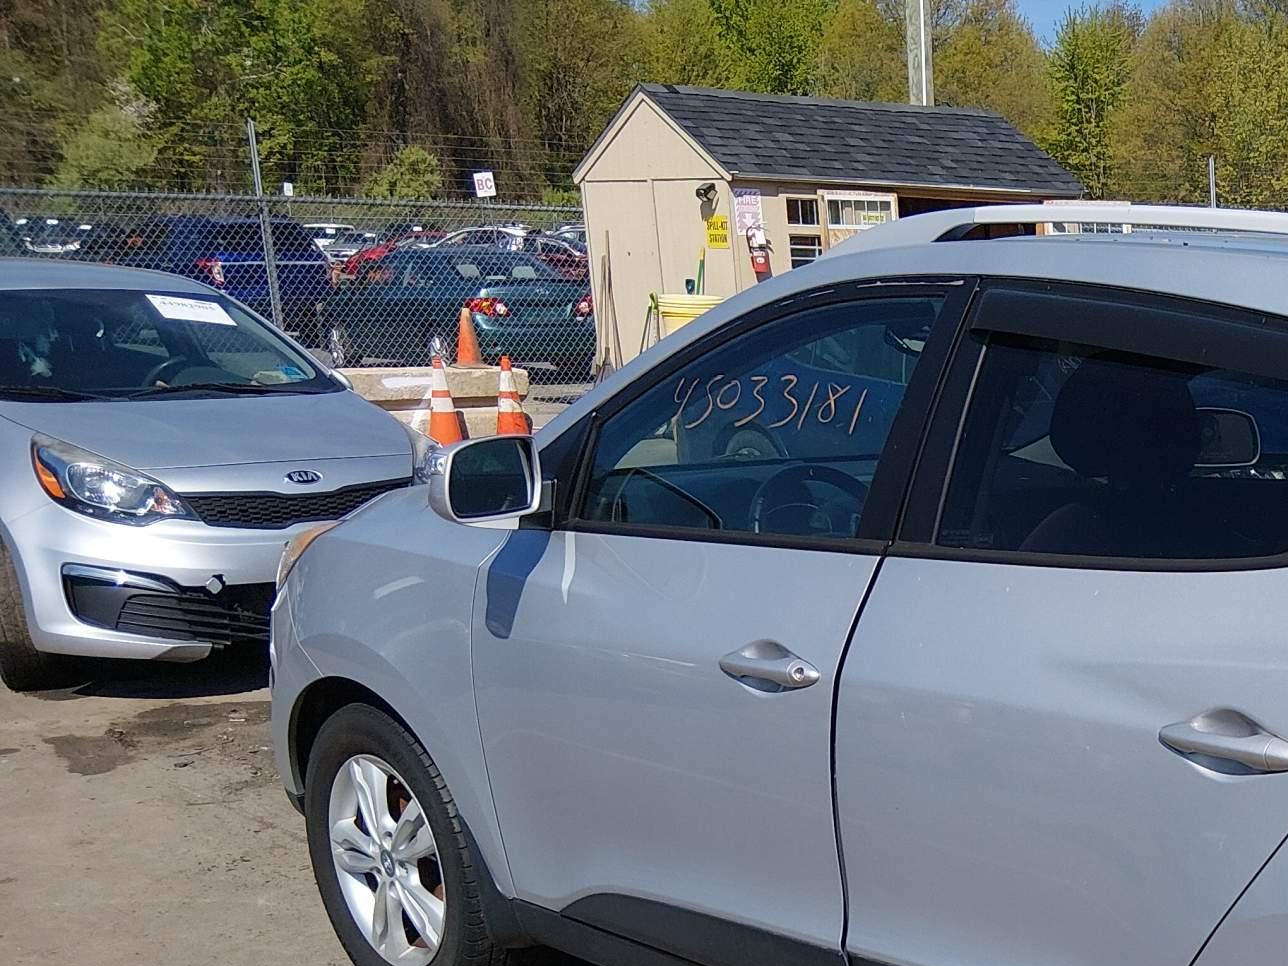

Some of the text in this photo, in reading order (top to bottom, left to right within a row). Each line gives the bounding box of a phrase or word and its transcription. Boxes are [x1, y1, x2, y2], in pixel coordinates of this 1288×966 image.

[476, 178, 493, 191] BC
[673, 374, 868, 434] 45033181
[290, 471, 319, 482] KIA
